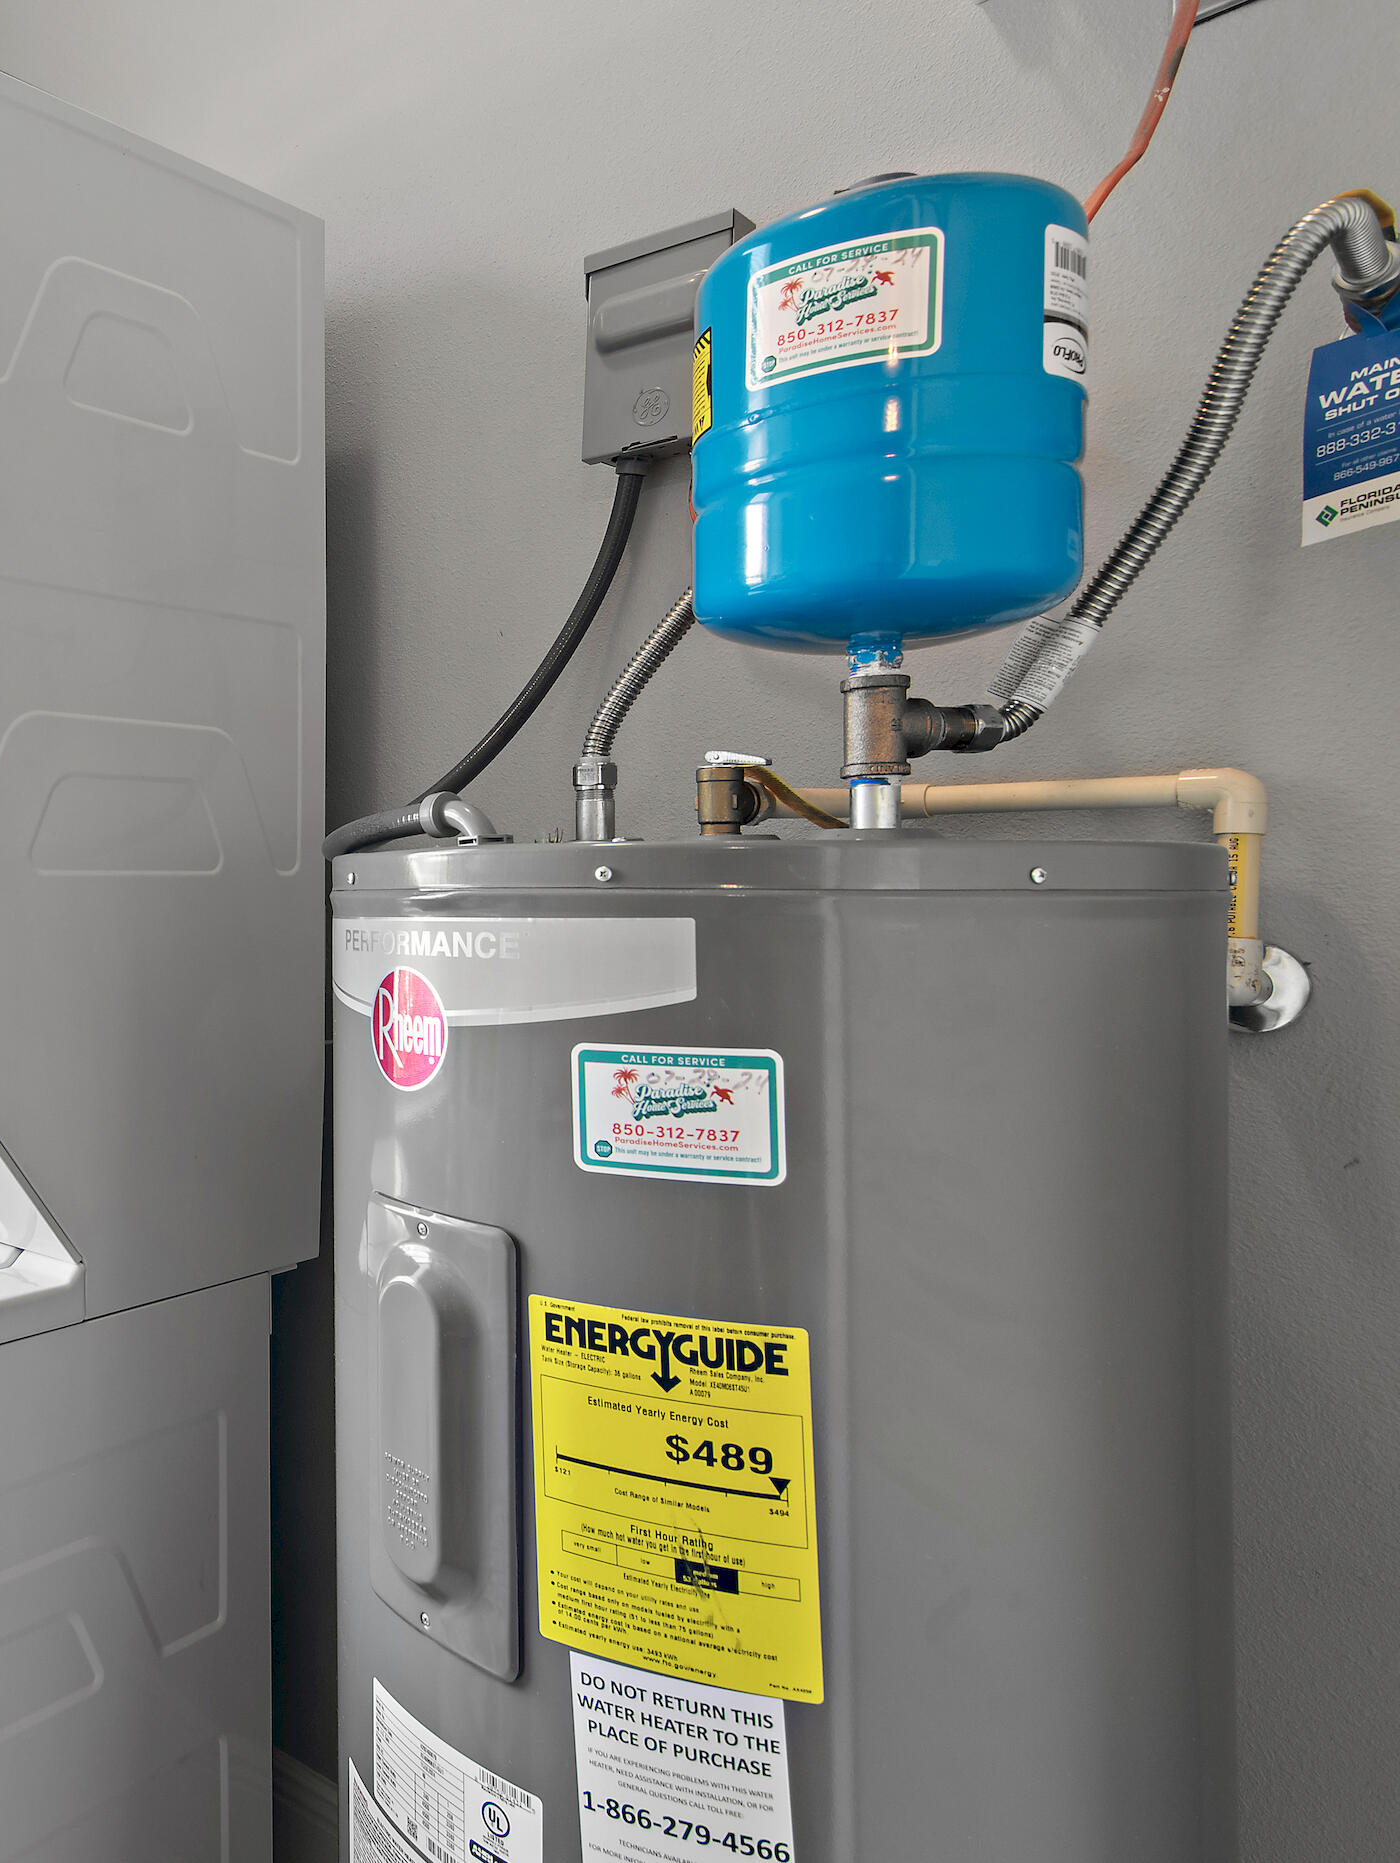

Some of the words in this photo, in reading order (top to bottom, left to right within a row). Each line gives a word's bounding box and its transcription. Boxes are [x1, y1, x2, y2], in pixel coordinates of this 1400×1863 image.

[788, 261, 814, 275] CALL
[816, 254, 838, 267] FOR
[841, 243, 889, 260] SERVICE
[799, 275, 868, 307] Paradise
[777, 309, 899, 346] 850-312-7837
[779, 324, 896, 354] ParadiseHomeServices.com
[1325, 394, 1379, 421] SHUT
[345, 929, 520, 959] PERFORMANCE
[378, 967, 442, 1068] Rheem
[621, 1055, 648, 1064] CALL
[652, 1056, 674, 1065] FOR
[678, 1057, 726, 1066] SERVICE
[634, 1083, 707, 1101] Paradise
[633, 1100, 669, 1121] Home
[669, 1098, 717, 1118] Services
[612, 1123, 740, 1142] 850-312-7837
[614, 1137, 739, 1151] ParadiseHomeServices.com
[596, 1144, 611, 1153] STOP
[550, 1302, 575, 1311] Government
[541, 1345, 555, 1353] Water
[557, 1348, 572, 1357] Heater
[581, 1353, 606, 1363] ELECTRIC
[544, 1312, 789, 1378] ENERGYGUIDE
[542, 1355, 553, 1363] Tank
[566, 1360, 586, 1371] (Storage
[588, 1365, 611, 1376] Capacity):
[622, 1372, 641, 1381] gallons
[689, 1367, 708, 1376] Rheem
[710, 1370, 724, 1378] Sales
[726, 1372, 753, 1382] Company,
[587, 1396, 632, 1413] Estimated
[635, 1405, 666, 1420] Yearly
[669, 1411, 704, 1427] Energy
[707, 1417, 729, 1429] Cost
[665, 1433, 773, 1475] $489
[554, 1466, 571, 1477] $121
[614, 1487, 628, 1497] Cost
[630, 1491, 650, 1502] Range
[660, 1497, 684, 1508] Similar
[685, 1502, 710, 1513] Models
[768, 1508, 790, 1518] $494
[573, 1541, 585, 1550] very
[586, 1544, 601, 1552] small
[580, 1523, 595, 1535] (How
[598, 1527, 614, 1539] much
[615, 1532, 625, 1542] hot
[627, 1536, 644, 1546] water
[646, 1539, 657, 1550] you
[659, 1542, 669, 1553] get
[671, 1545, 677, 1554] in
[679, 1545, 689, 1557] the
[691, 1548, 704, 1559] first
[705, 1551, 721, 1562] hour
[723, 1554, 730, 1563] of
[732, 1556, 746, 1567] use)
[630, 1525, 651, 1538] First
[655, 1530, 678, 1543] Hour
[682, 1535, 714, 1552] Rating
[624, 1573, 650, 1586] Estimated
[651, 1579, 668, 1591] Yearly
[670, 1584, 699, 1598] Electricity
[761, 1582, 775, 1590] high
[643, 1655, 717, 1678] www.ftc.gov/energy
[580, 1671, 606, 1691] DO
[610, 1681, 647, 1702] NOT
[652, 1691, 726, 1721] RETURN
[731, 1708, 774, 1729] THIS
[577, 1693, 636, 1723] WATER
[640, 1712, 709, 1741] HEATER
[712, 1728, 738, 1746] TO
[743, 1735, 781, 1755] THE
[588, 1719, 639, 1747] PLACE
[644, 1737, 667, 1754] OF
[673, 1743, 772, 1778] PURCHASE
[589, 1759, 615, 1773] HEATER,
[616, 1767, 634, 1778] NEED
[634, 1774, 674, 1790] ASSISTANCE
[675, 1784, 694, 1794] WITH
[695, 1790, 746, 1807] INSTALLATION,
[746, 1801, 758, 1809] OR
[594, 1749, 608, 1759] YOU
[609, 1754, 622, 1763] ARE
[623, 1758, 671, 1777] EXPERIENCING
[672, 1772, 710, 1787] PROBLEMS
[710, 1781, 730, 1791] WITH
[731, 1785, 747, 1794] THIS
[748, 1788, 774, 1799] WATER
[617, 1780, 648, 1795] GENERAL
[648, 1789, 688, 1806] QUESTIONS
[688, 1800, 706, 1810] CALL
[706, 1804, 724, 1815] TOLL
[488, 1806, 504, 1833] UL
[582, 1790, 791, 1863] 1-866-279-4566
[588, 1842, 601, 1852] FOR
[602, 1847, 622, 1859] MORE
[618, 1838, 662, 1859] TECHNICIANS
